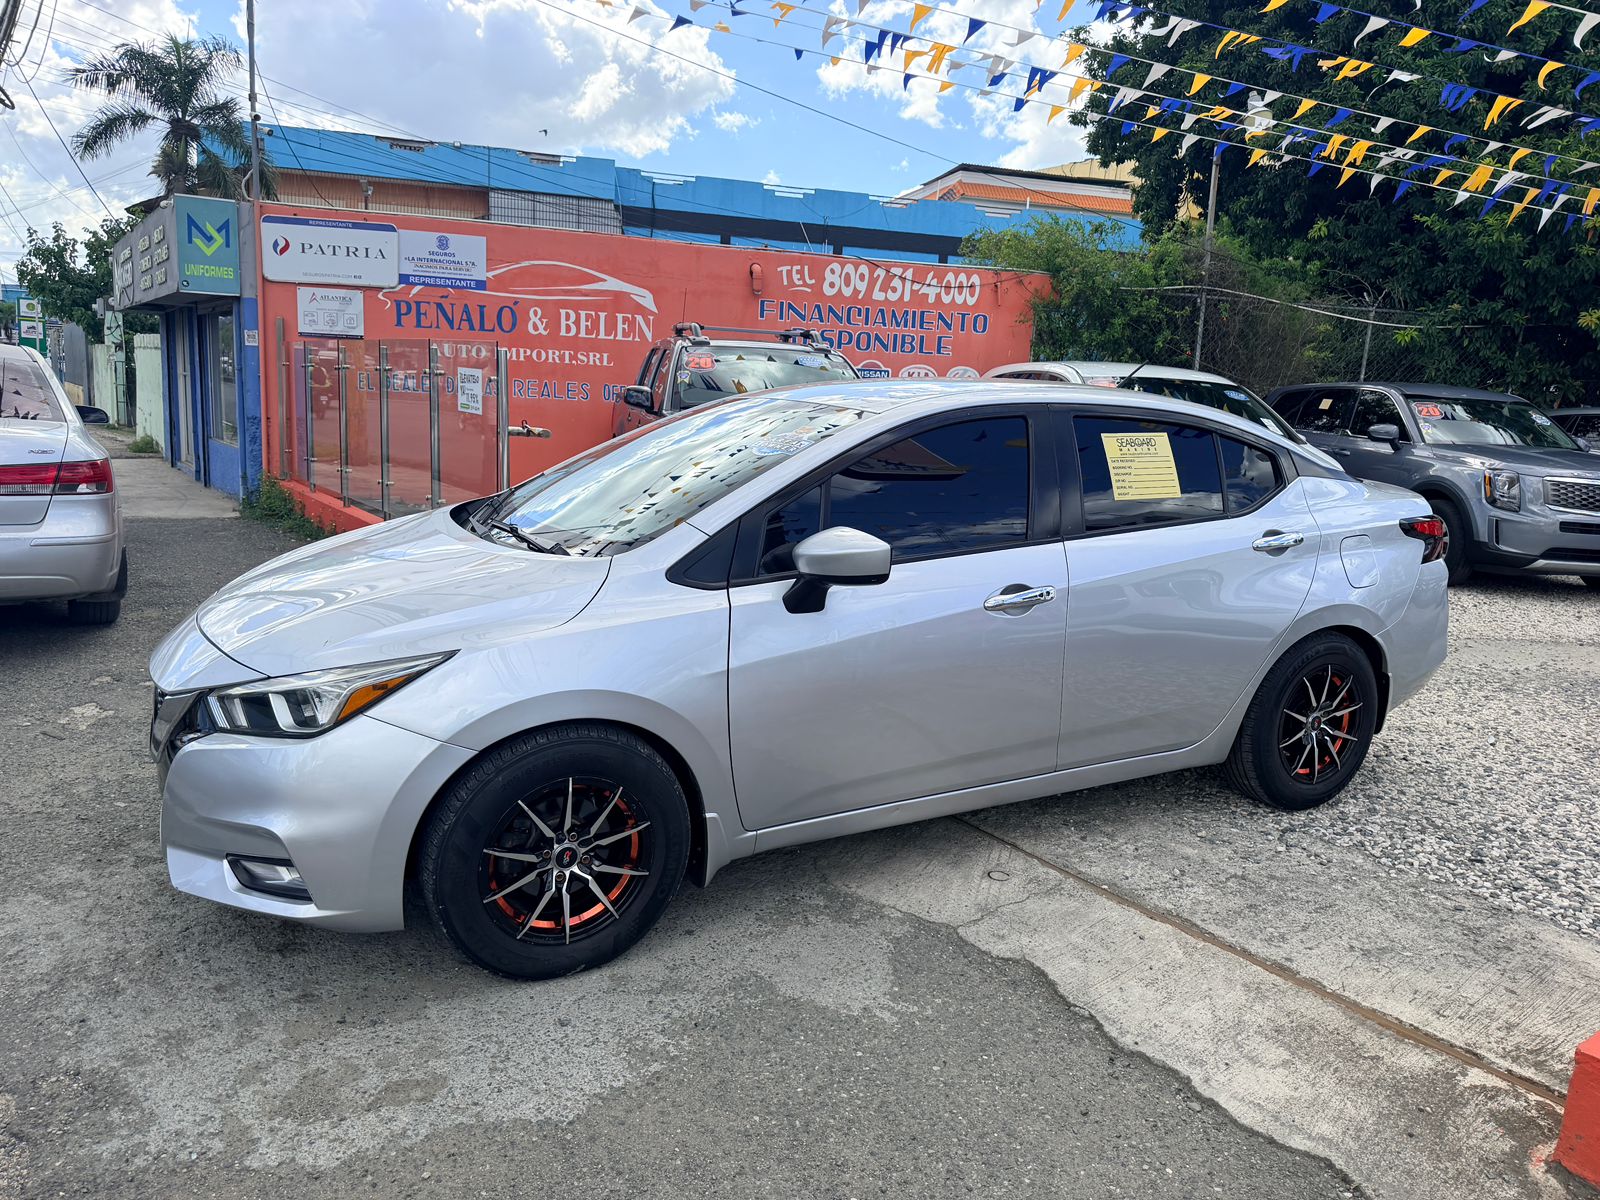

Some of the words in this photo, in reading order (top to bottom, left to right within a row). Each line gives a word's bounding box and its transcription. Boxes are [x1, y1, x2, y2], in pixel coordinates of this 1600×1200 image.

[308, 219, 353, 228] REPRESENTANTE
[300, 242, 387, 260] PATRIA
[416, 257, 464, 266] INTERNACIONAL
[185, 264, 234, 279] UNIFORMES
[409, 276, 476, 287] REPRESENTANTE
[777, 264, 816, 288] TEL
[822, 263, 869, 300] 809
[872, 266, 981, 306] 231-4000
[527, 307, 549, 335] &
[559, 308, 654, 343] BELEN
[758, 300, 989, 335] FINANCIAMIENTO
[790, 326, 954, 357] DSPONIBLE
[495, 347, 614, 366] MPORT,SRL
[688, 357, 712, 369] 20
[358, 371, 375, 391] EL
[384, 372, 431, 393] DEALE
[512, 378, 591, 400] REALES
[1420, 406, 1440, 416] 20
[1116, 438, 1157, 447] SEABOARD
